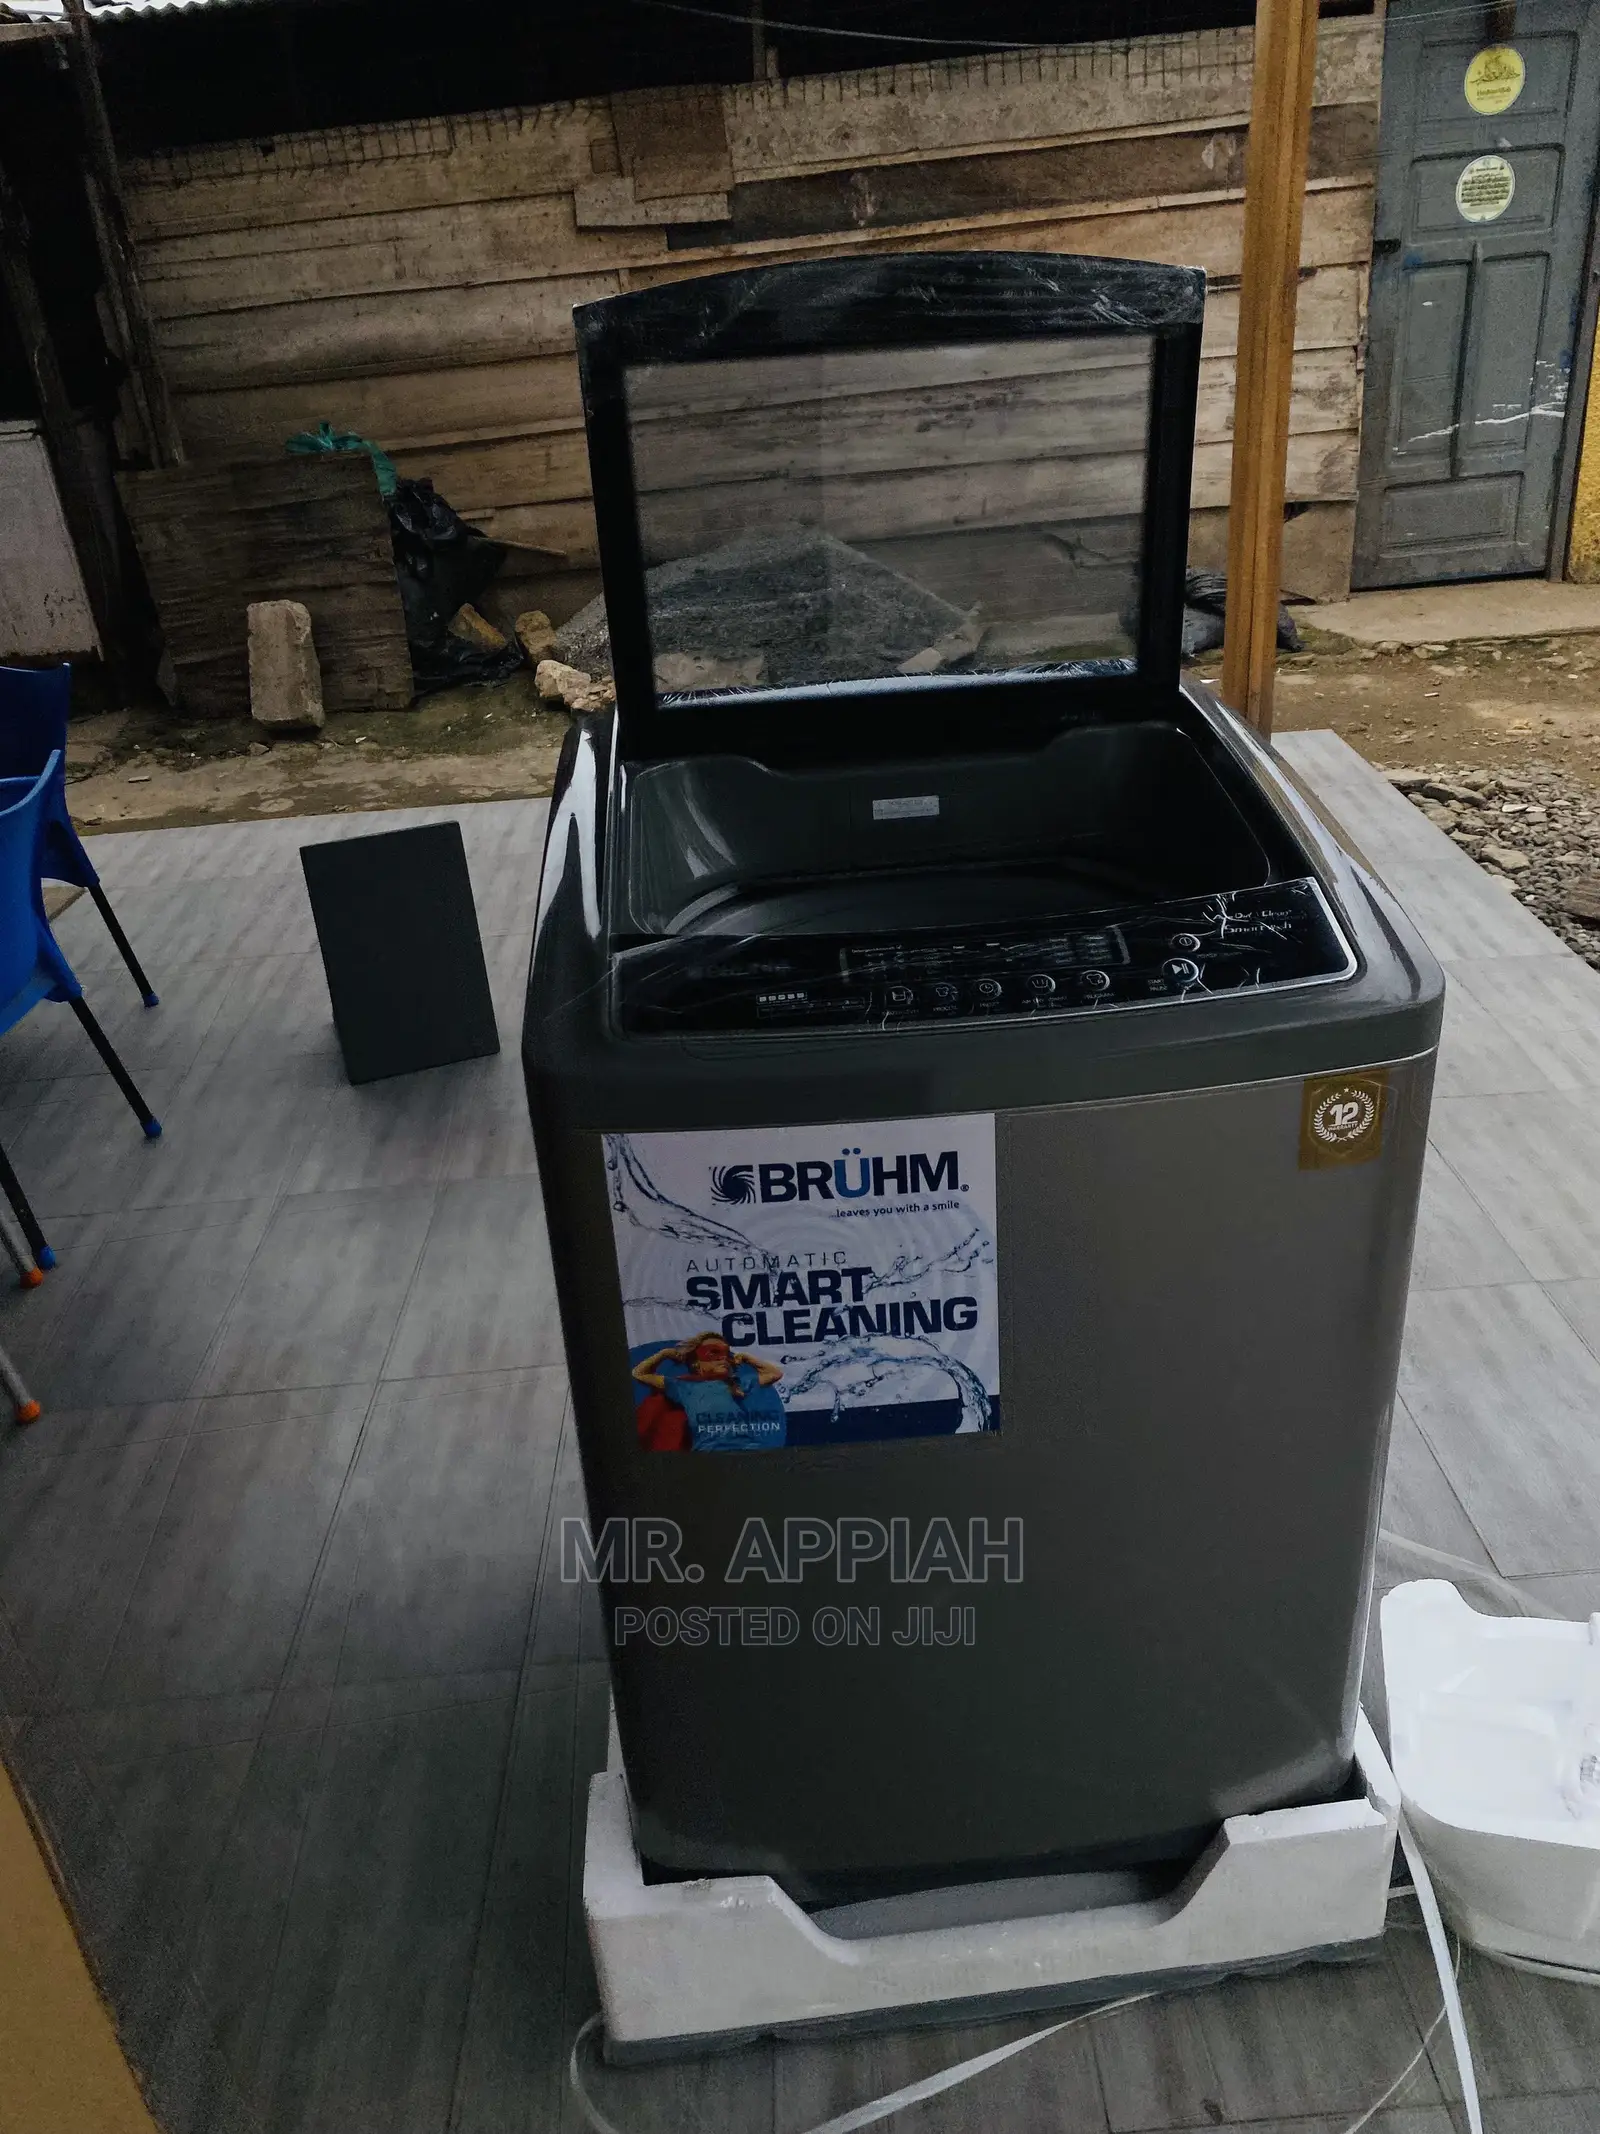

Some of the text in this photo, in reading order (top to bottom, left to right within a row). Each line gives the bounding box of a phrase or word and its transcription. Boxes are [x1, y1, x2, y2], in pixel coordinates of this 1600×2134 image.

[1329, 1101, 1359, 1126] 12
[873, 1206, 893, 1217] you
[896, 1203, 920, 1213] with
[932, 1200, 960, 1211] smile
[686, 1251, 848, 1273] AUTOMATIC
[686, 1266, 873, 1311] SMART
[722, 1296, 978, 1347] CLEANING
[698, 1421, 781, 1434] PERFECTION
